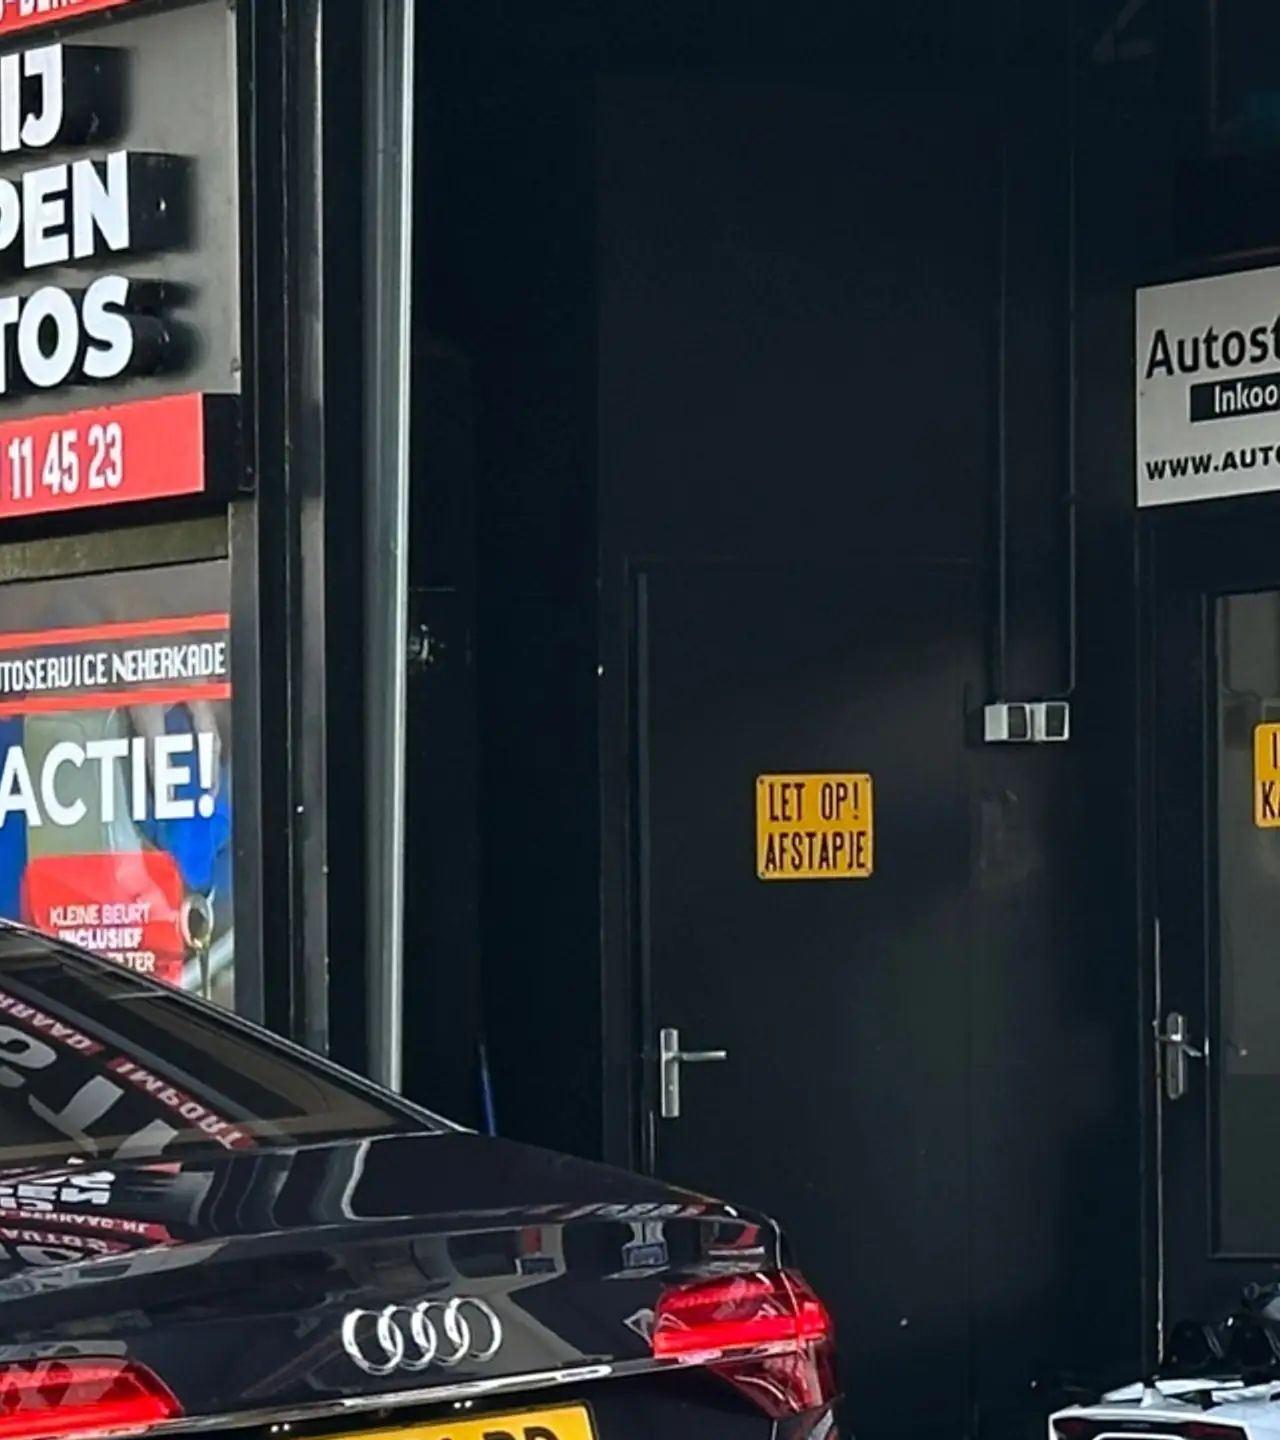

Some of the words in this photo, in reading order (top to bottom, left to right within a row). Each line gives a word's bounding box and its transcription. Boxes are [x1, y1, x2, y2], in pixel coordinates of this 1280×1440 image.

[8, 435, 34, 500] 11
[42, 429, 80, 494] 45
[87, 421, 123, 489] 23
[112, 642, 226, 683] NEHERKADE
[769, 782, 806, 822] LET
[821, 781, 859, 821] OP!
[765, 830, 868, 873] AFSTAPJE
[50, 904, 100, 927] KLEINE
[102, 902, 151, 924] BEURT
